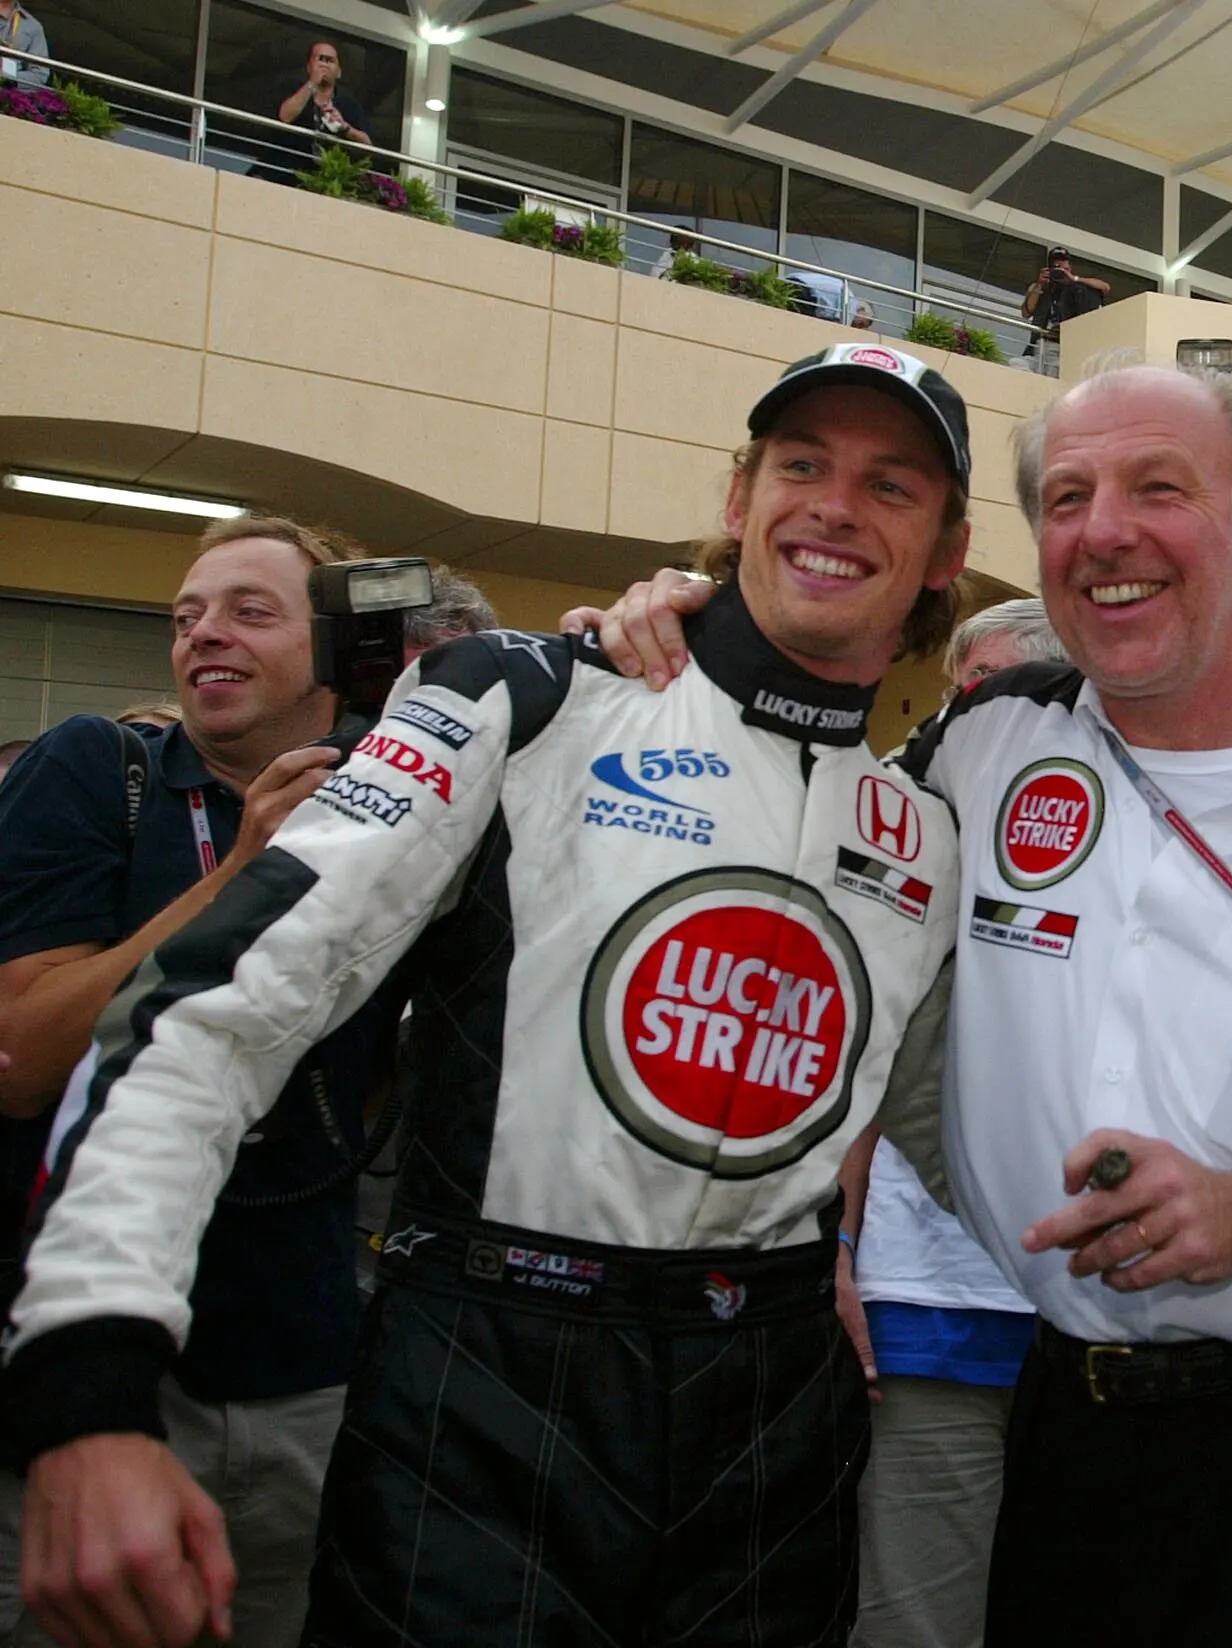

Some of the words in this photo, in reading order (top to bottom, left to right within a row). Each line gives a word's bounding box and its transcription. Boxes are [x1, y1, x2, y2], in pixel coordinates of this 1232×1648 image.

[754, 689, 820, 726] LUCKY
[640, 748, 731, 782] 555
[587, 797, 716, 831] WORLD
[1018, 794, 1085, 824] LUCKY
[583, 812, 712, 846] RACING
[1009, 820, 1078, 851] STRIKE
[655, 939, 835, 1037] LUCKY
[636, 998, 826, 1097] STRIKE
